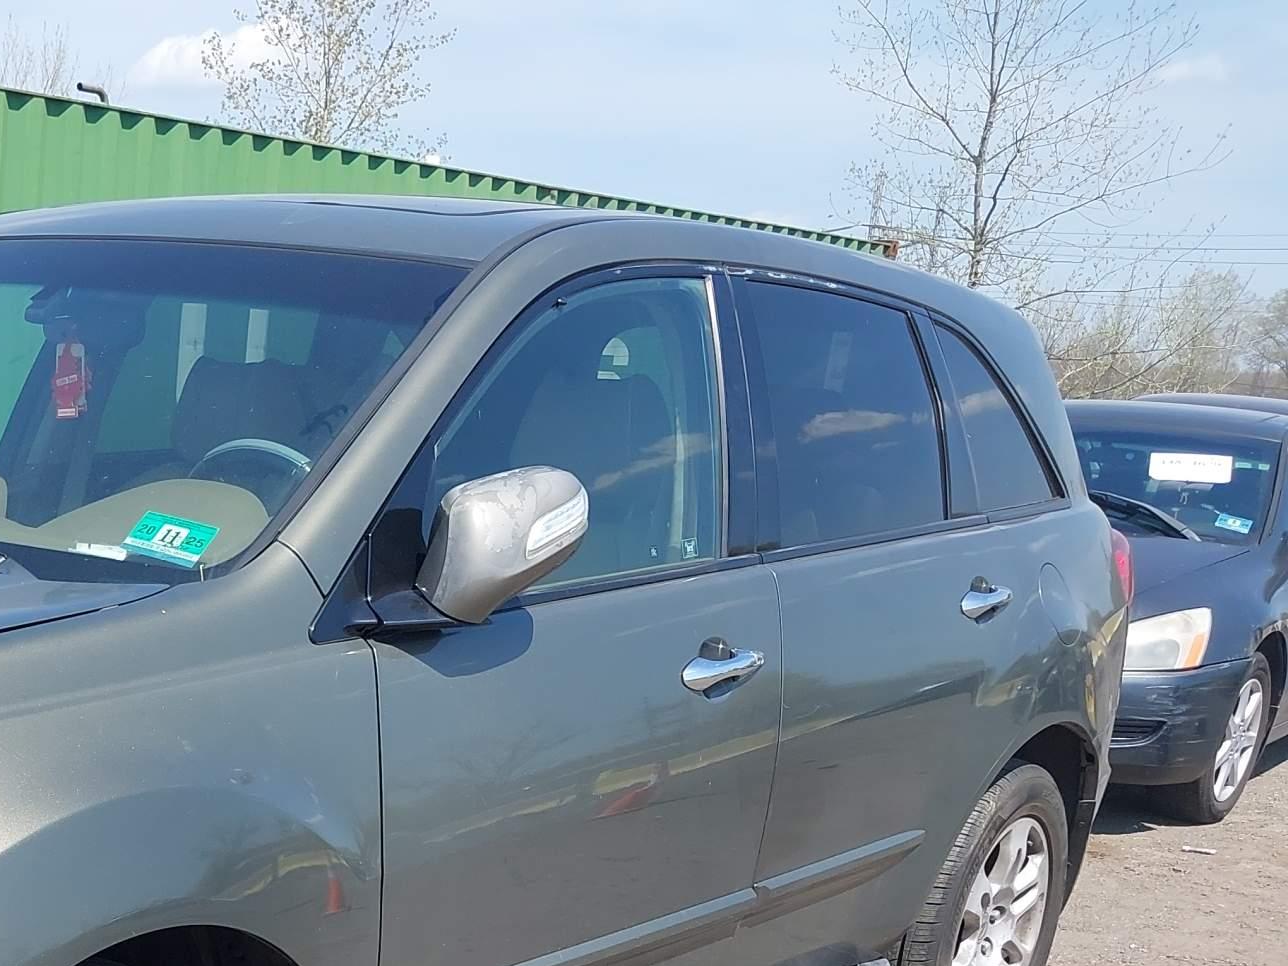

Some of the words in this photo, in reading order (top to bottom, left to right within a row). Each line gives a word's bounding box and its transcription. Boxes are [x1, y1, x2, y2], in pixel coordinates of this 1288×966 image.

[137, 523, 156, 535] 20
[158, 528, 181, 545] 11
[185, 536, 203, 548] 25
